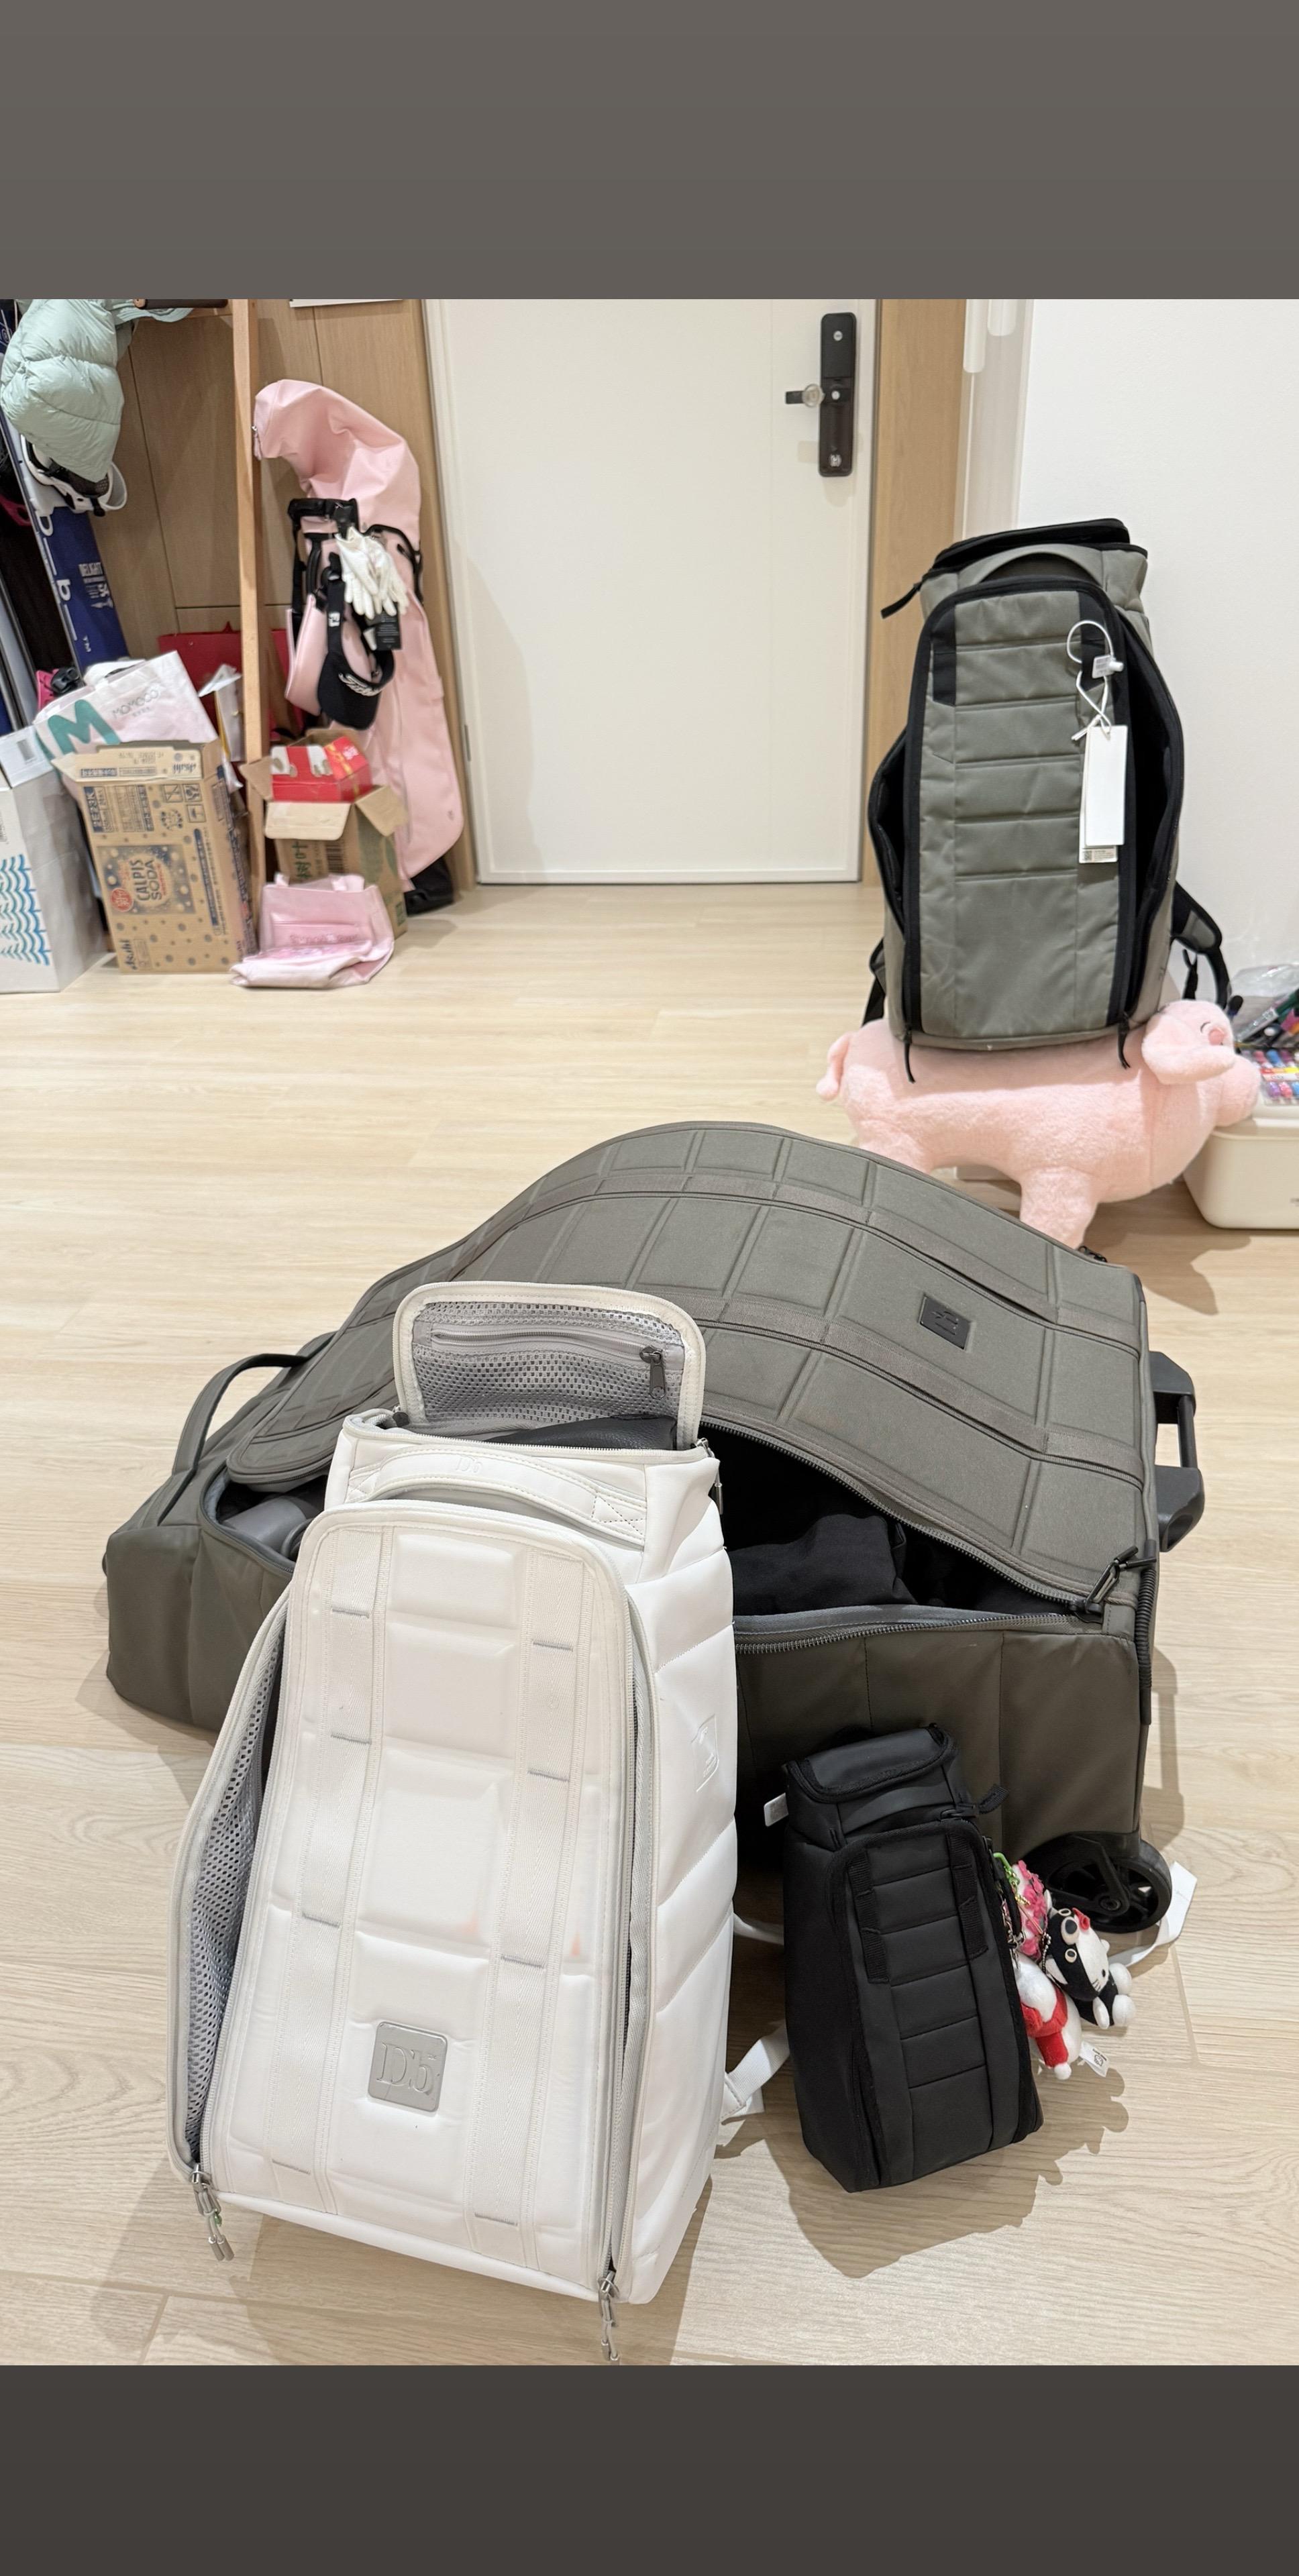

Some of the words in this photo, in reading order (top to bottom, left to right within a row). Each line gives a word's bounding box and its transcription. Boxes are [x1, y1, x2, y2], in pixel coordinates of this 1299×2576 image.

[48, 699, 121, 755] M
[131, 860, 150, 902] CALPIS
[145, 859, 162, 900] SODA
